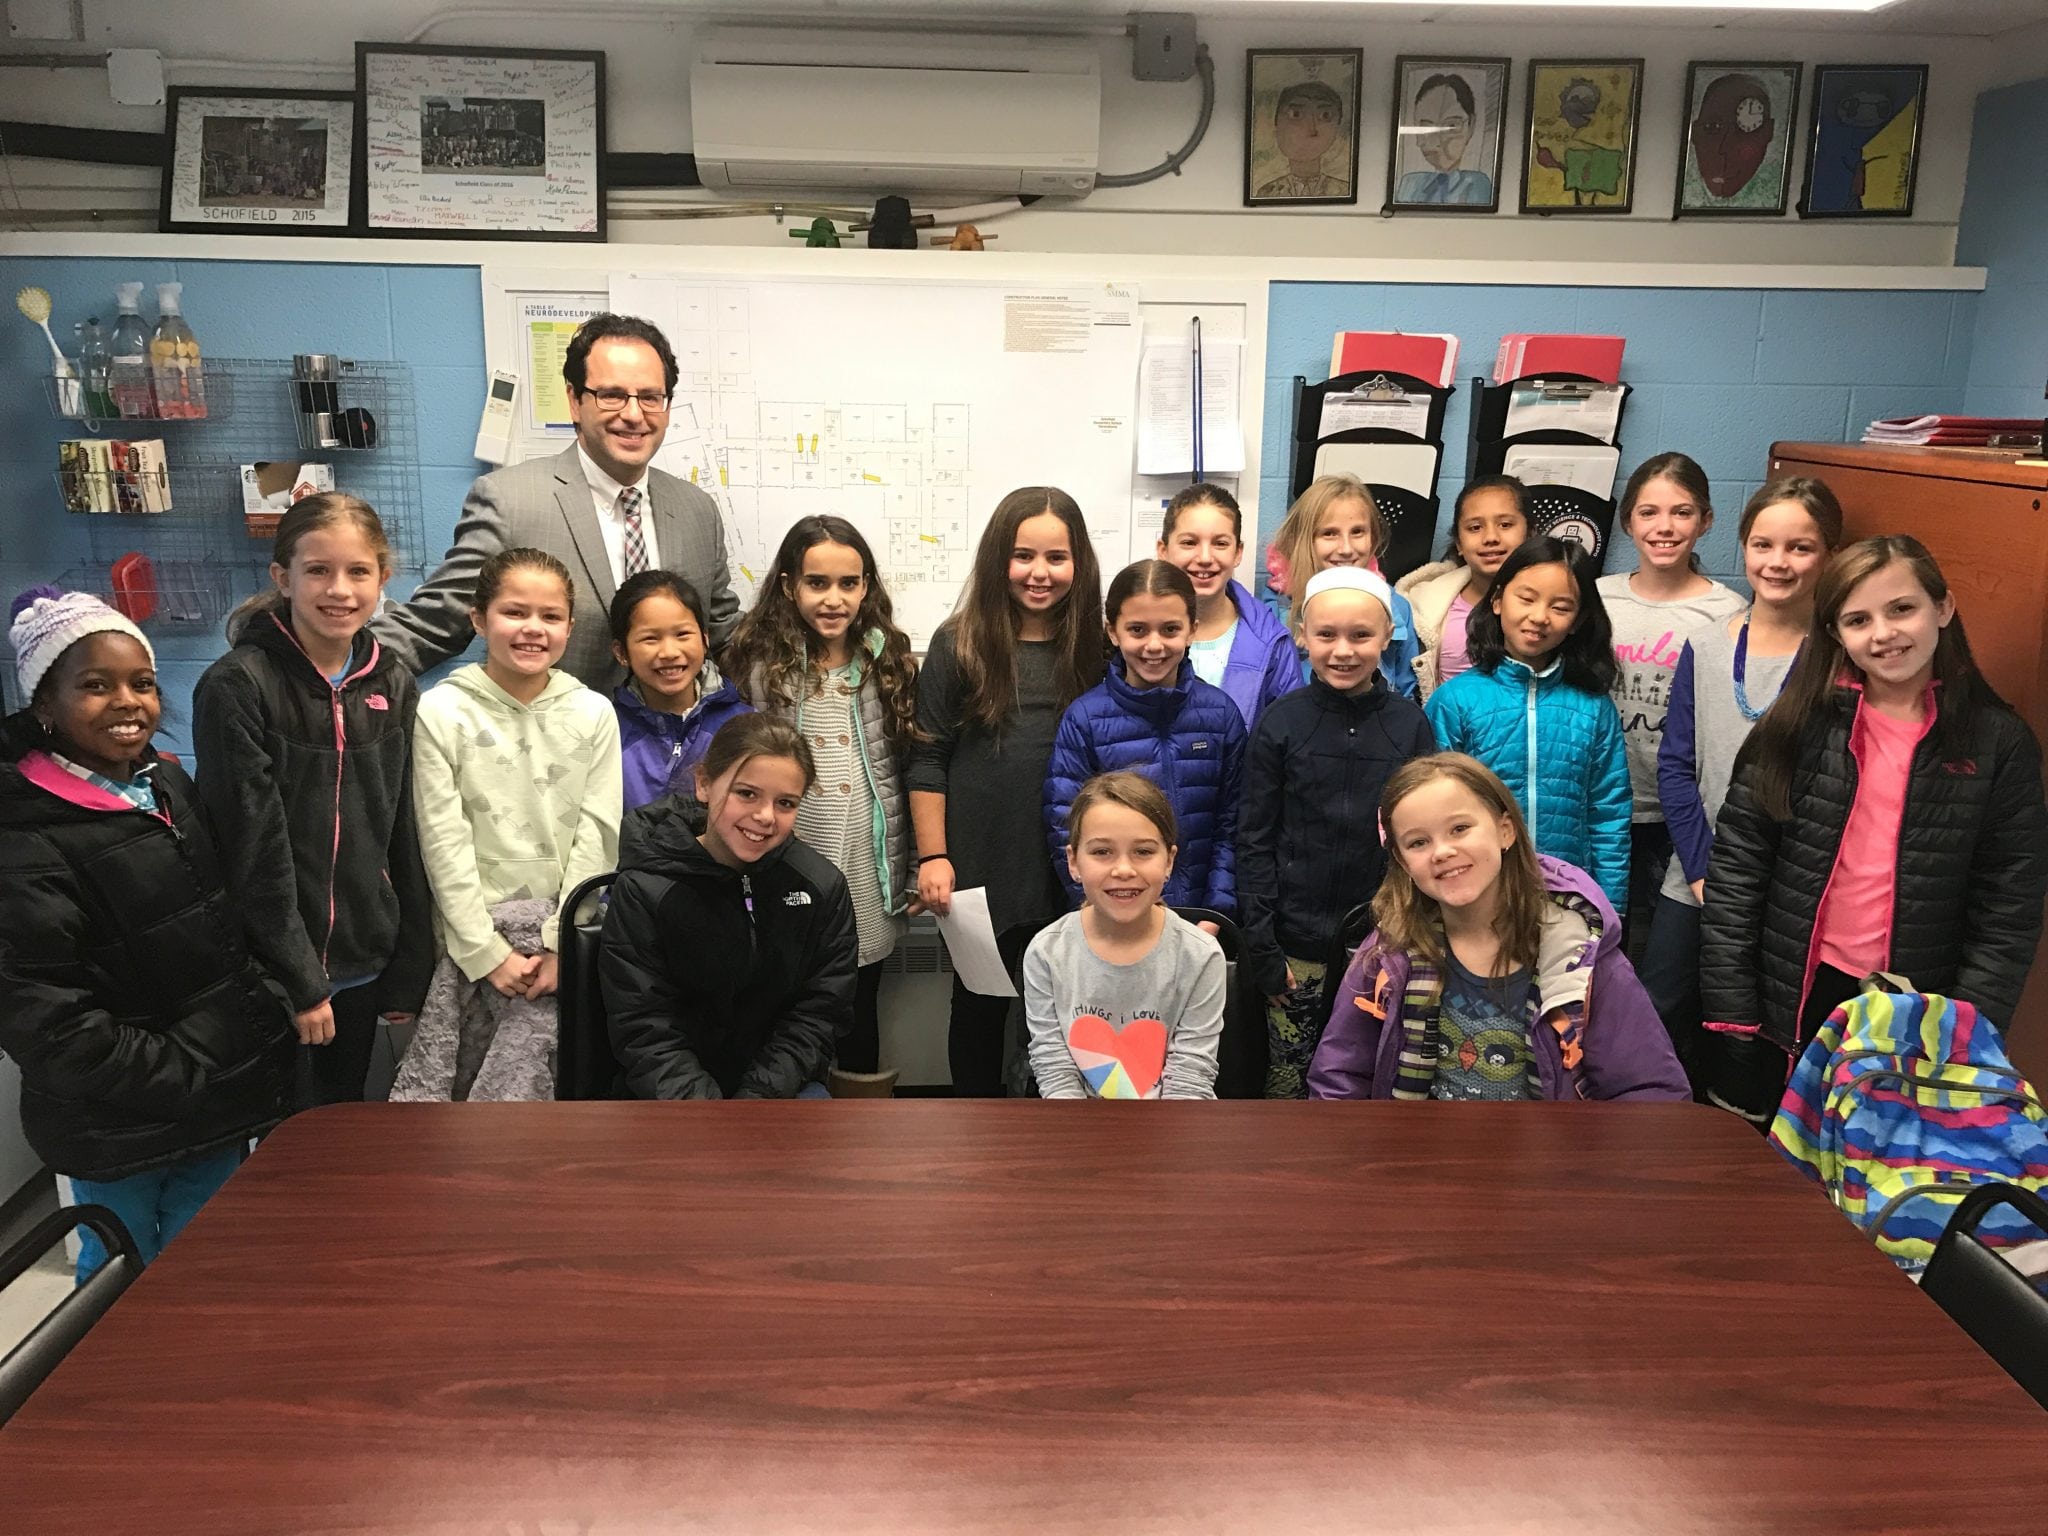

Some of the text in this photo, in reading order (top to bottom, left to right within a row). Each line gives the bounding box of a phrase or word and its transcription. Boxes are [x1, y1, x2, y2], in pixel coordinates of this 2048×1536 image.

[203, 207, 316, 221] SCHOFIELD 2015
[1106, 290, 1130, 298] SMMA
[1552, 514, 1575, 526] SCIENCE
[1616, 631, 1680, 671] mile
[1132, 1010, 1161, 1021] LOVE
